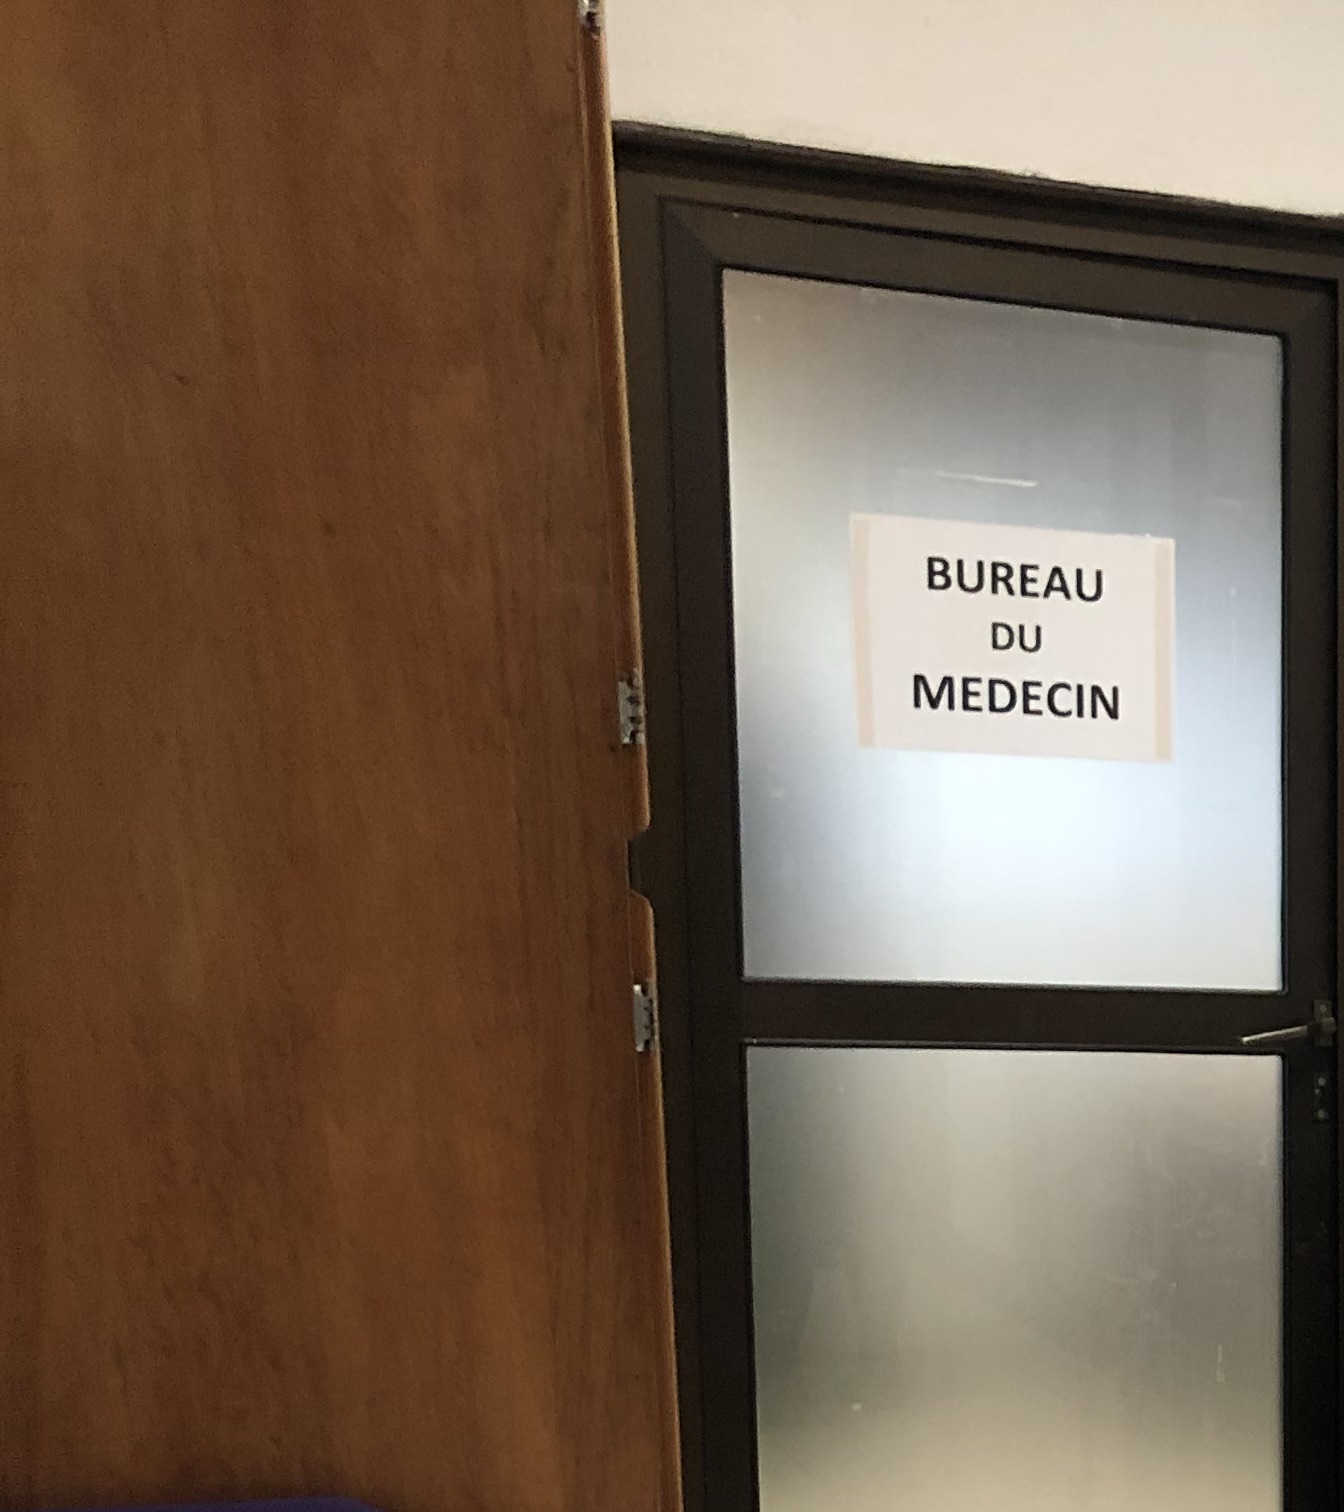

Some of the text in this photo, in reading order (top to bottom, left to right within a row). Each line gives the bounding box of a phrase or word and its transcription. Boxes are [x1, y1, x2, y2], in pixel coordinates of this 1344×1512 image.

[926, 555, 1104, 604] BUREAU
[991, 621, 1043, 653] DU
[912, 672, 1121, 721] MEDECIN
